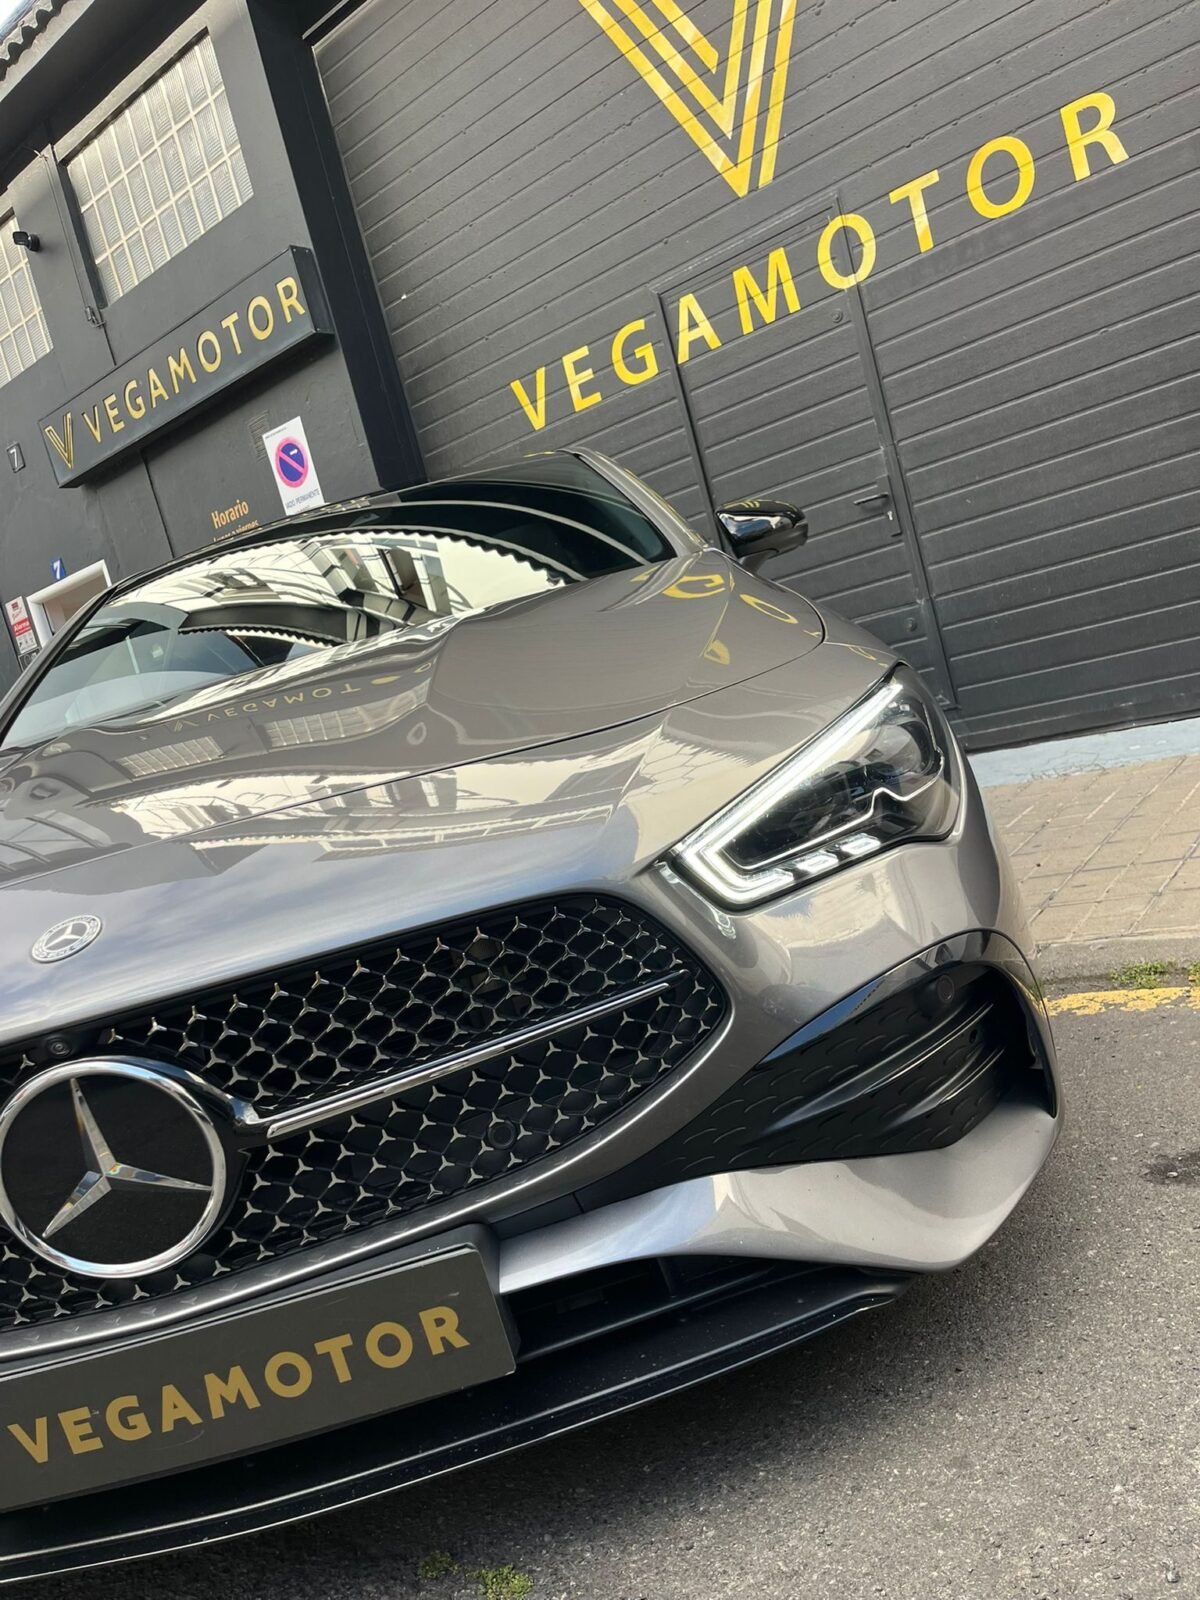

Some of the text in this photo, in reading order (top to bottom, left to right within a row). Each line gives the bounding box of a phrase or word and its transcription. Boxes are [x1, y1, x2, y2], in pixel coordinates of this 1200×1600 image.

[510, 92, 1129, 432] VEGAMOTOR
[82, 276, 306, 443] VEGAMOTOR
[53, 559, 61, 580] 7
[211, 499, 249, 529] Horario
[7, 1305, 470, 1464] VEGAMOTOR
